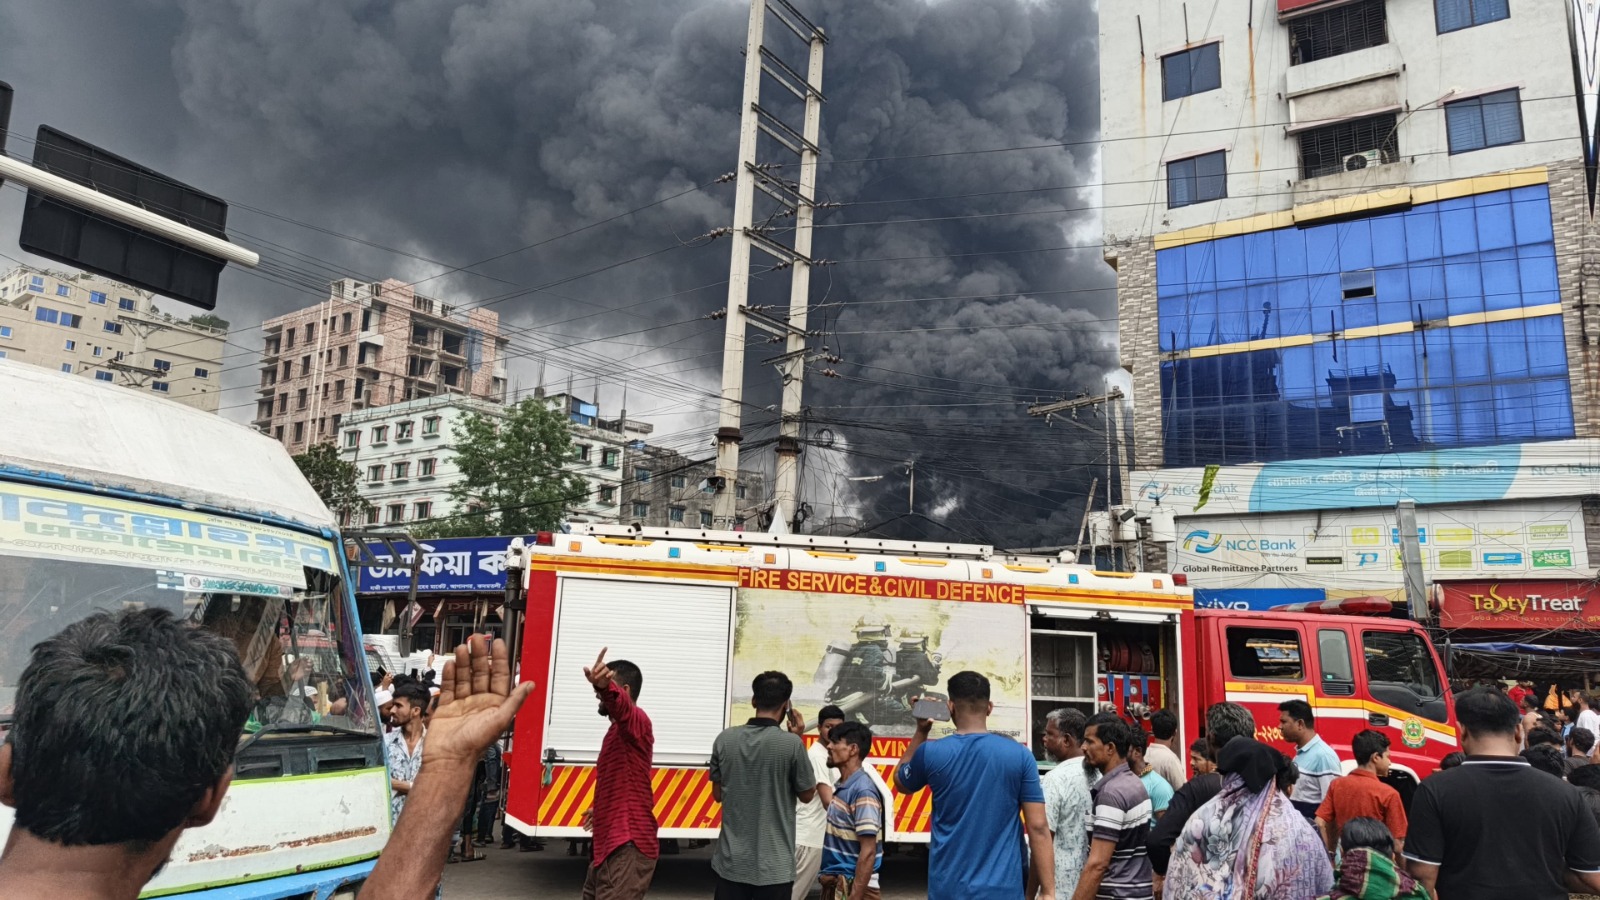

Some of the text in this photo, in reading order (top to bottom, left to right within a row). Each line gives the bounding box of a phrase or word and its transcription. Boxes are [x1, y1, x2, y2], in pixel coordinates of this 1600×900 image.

[1226, 538, 1297, 551] NCC Bank
[1182, 564, 1299, 573] Global Remittance Partners
[738, 568, 781, 588] FIRE
[787, 571, 867, 594] SERVICE
[884, 578, 932, 599] CIVIL
[936, 581, 1023, 604] DEFENCE
[1197, 597, 1250, 611] vivo
[869, 740, 911, 757] AVIN
